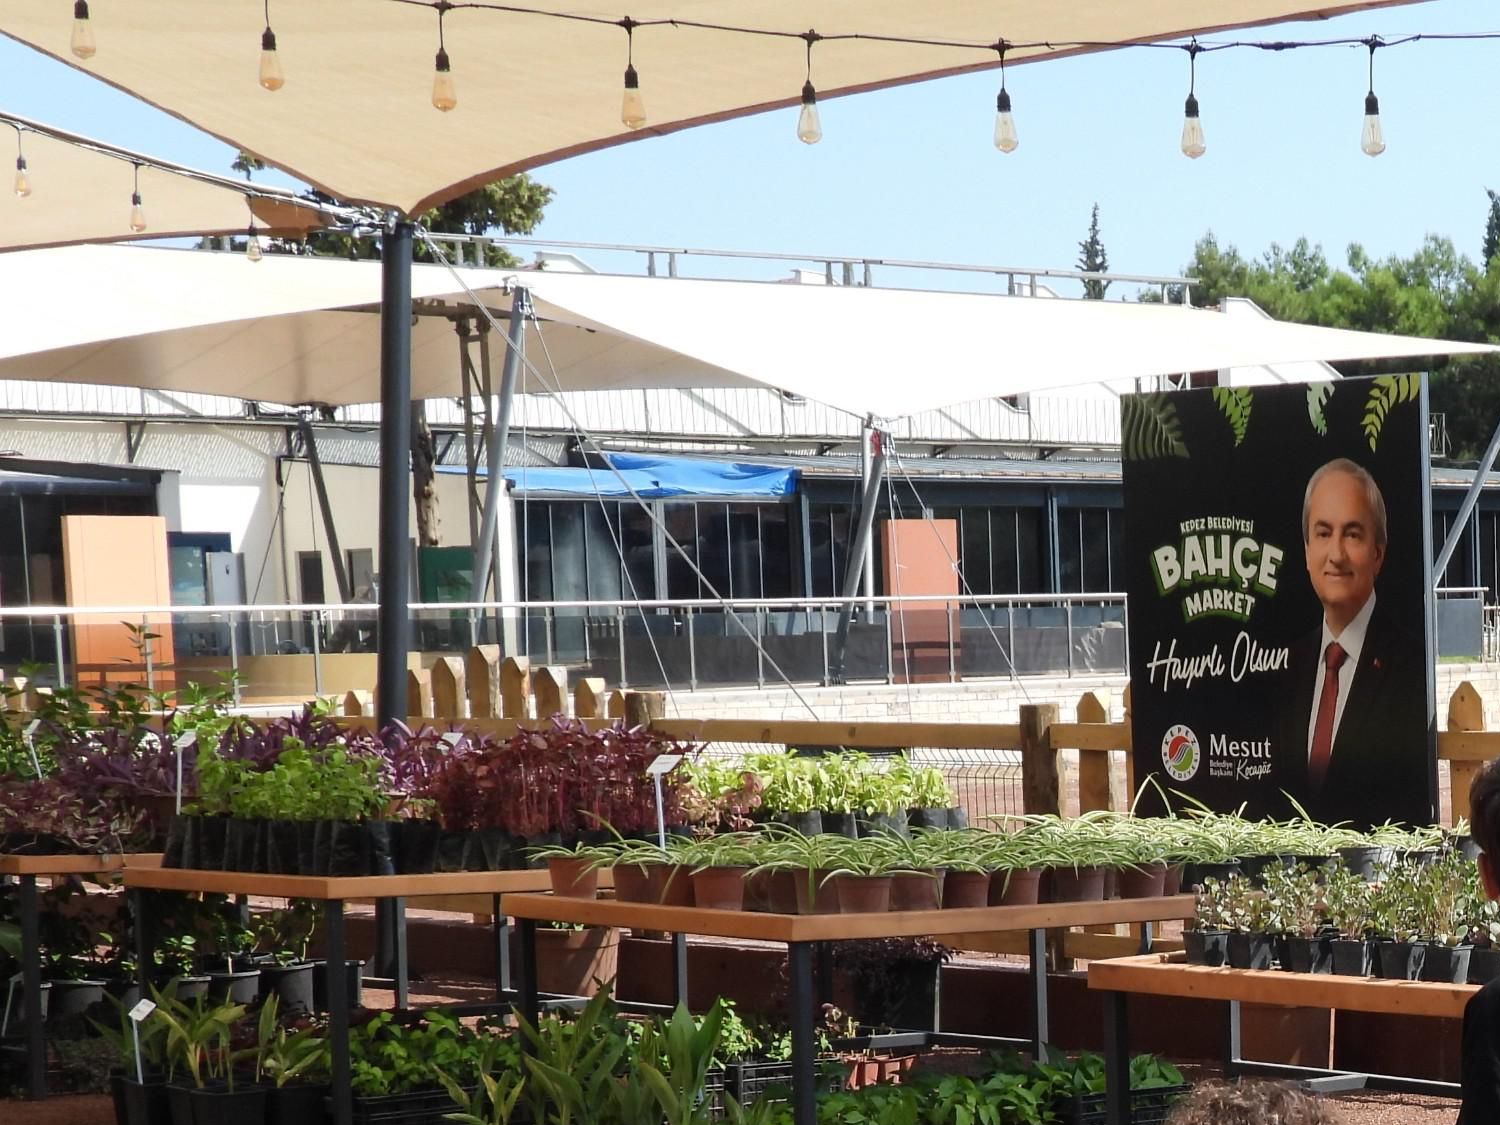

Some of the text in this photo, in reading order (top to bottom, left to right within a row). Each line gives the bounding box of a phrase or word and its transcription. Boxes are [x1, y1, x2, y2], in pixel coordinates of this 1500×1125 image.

[1180, 515, 1254, 534] KEPEZ BELEDİYESİ
[1153, 534, 1284, 590] BAHÇE
[1185, 588, 1255, 617] MARKET
[1146, 630, 1289, 692] Hayırlı Olsun
[1209, 733, 1272, 758] Mesut
[1209, 759, 1233, 770] Belediye
[1235, 758, 1272, 780] Kocagöz
